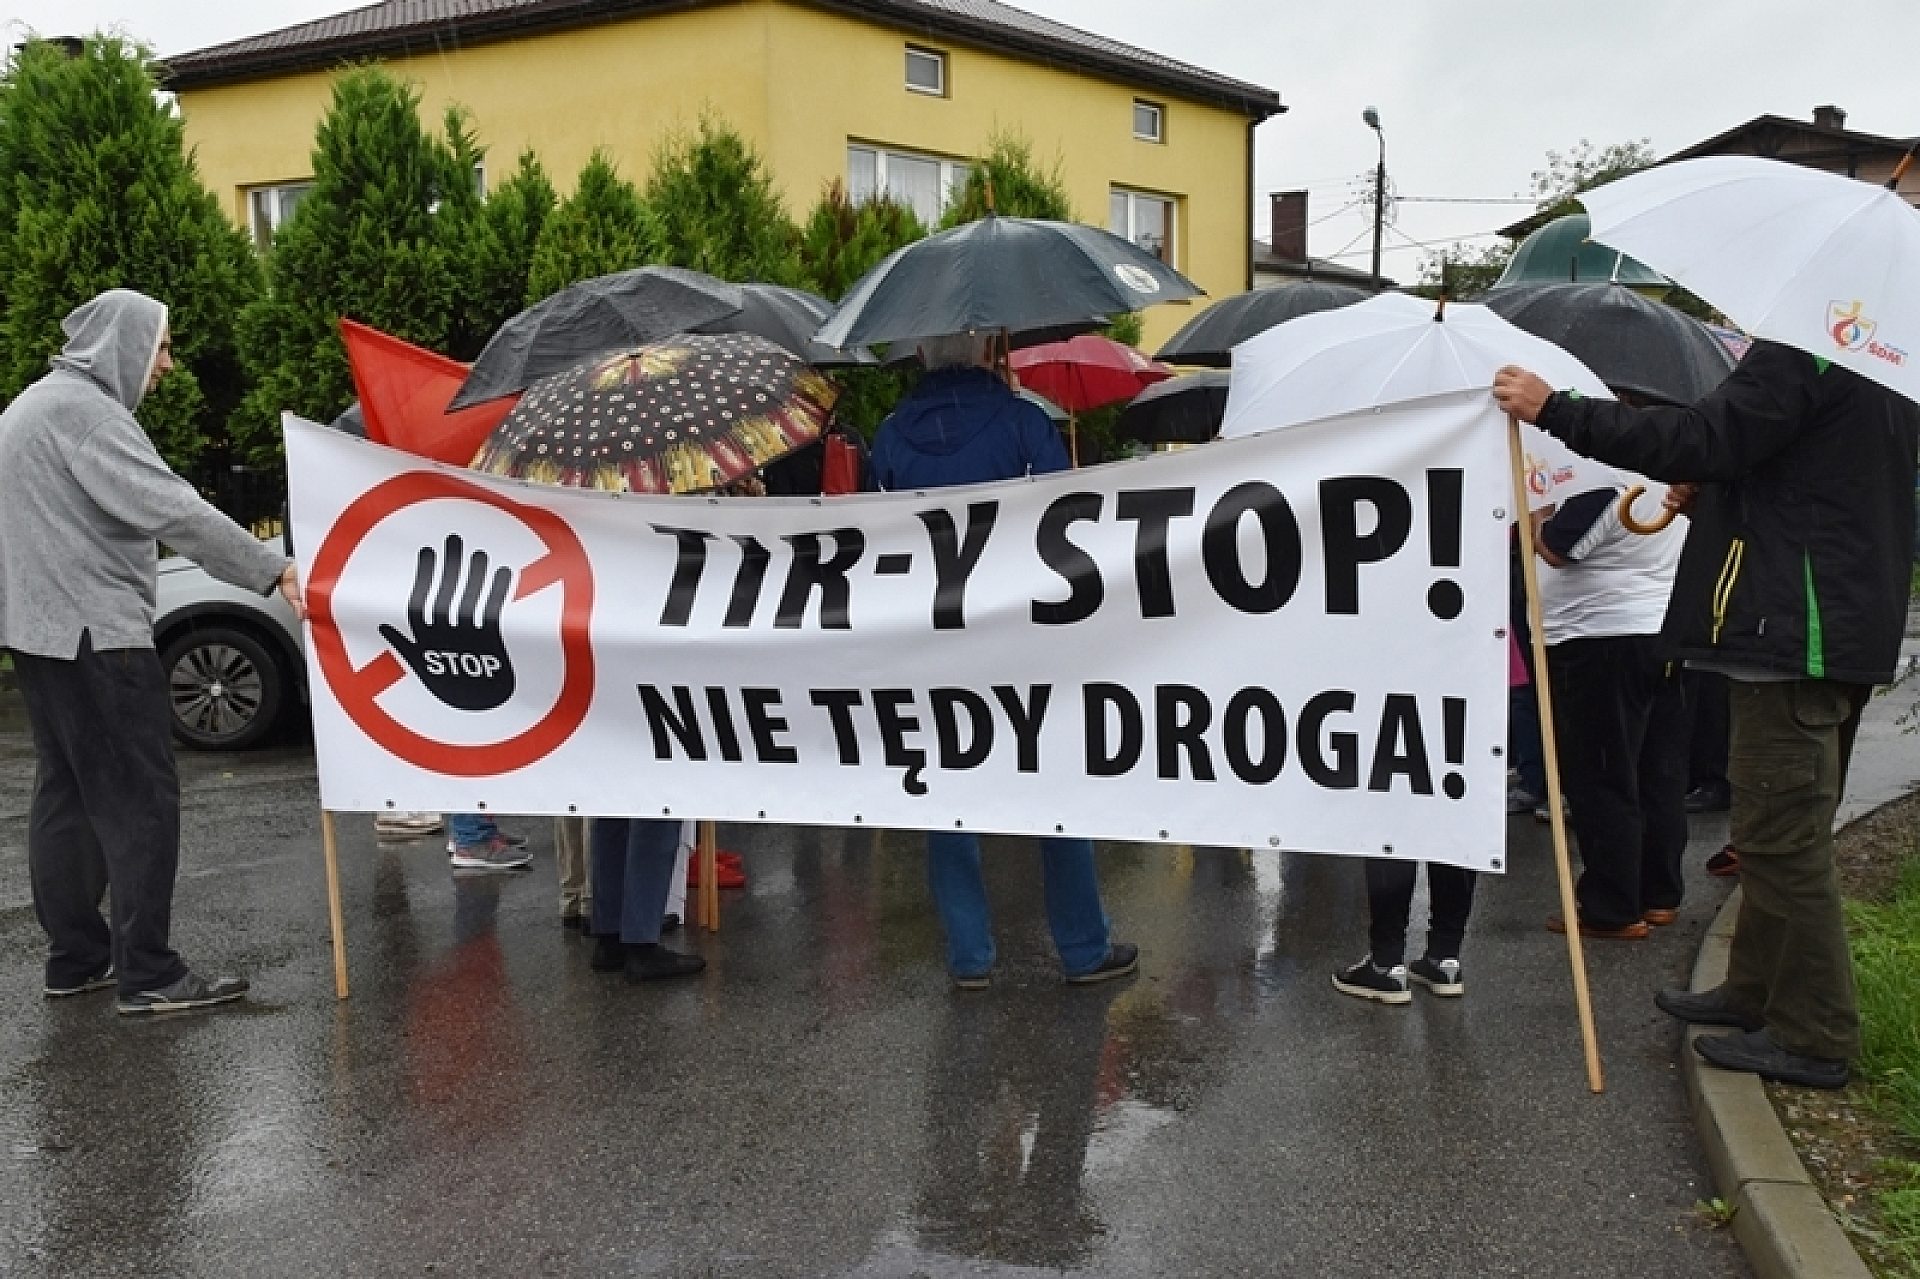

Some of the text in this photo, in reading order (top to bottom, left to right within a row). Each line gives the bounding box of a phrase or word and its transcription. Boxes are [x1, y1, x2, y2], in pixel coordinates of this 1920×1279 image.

[648, 467, 1464, 630] TIR-Y STOP!
[424, 650, 501, 678] STOP
[638, 683, 1467, 800] NIE TĘDY DROGA!
